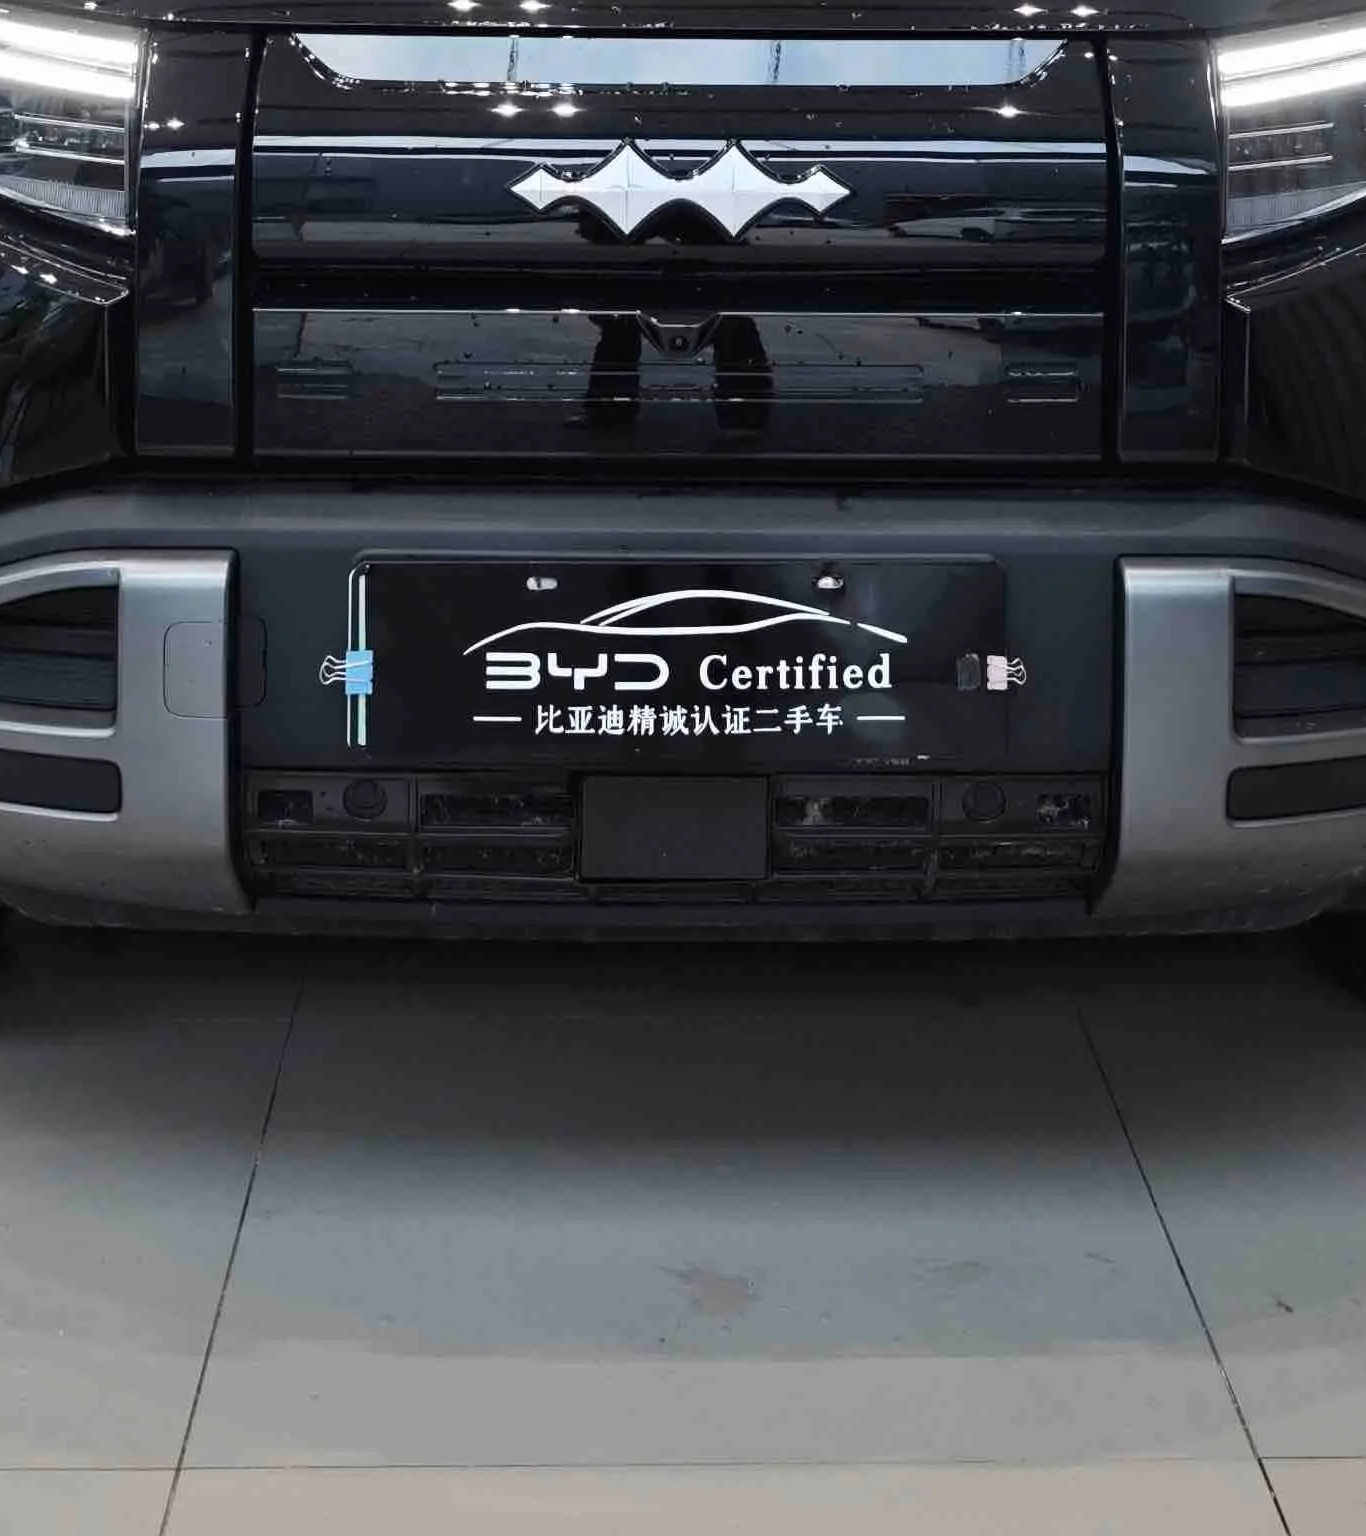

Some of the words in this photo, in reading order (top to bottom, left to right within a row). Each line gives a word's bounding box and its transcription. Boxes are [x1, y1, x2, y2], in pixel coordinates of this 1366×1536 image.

[485, 651, 669, 691] BYD
[698, 653, 893, 691] Certified
[533, 703, 844, 737] 比亚迪精诚认证二手车
